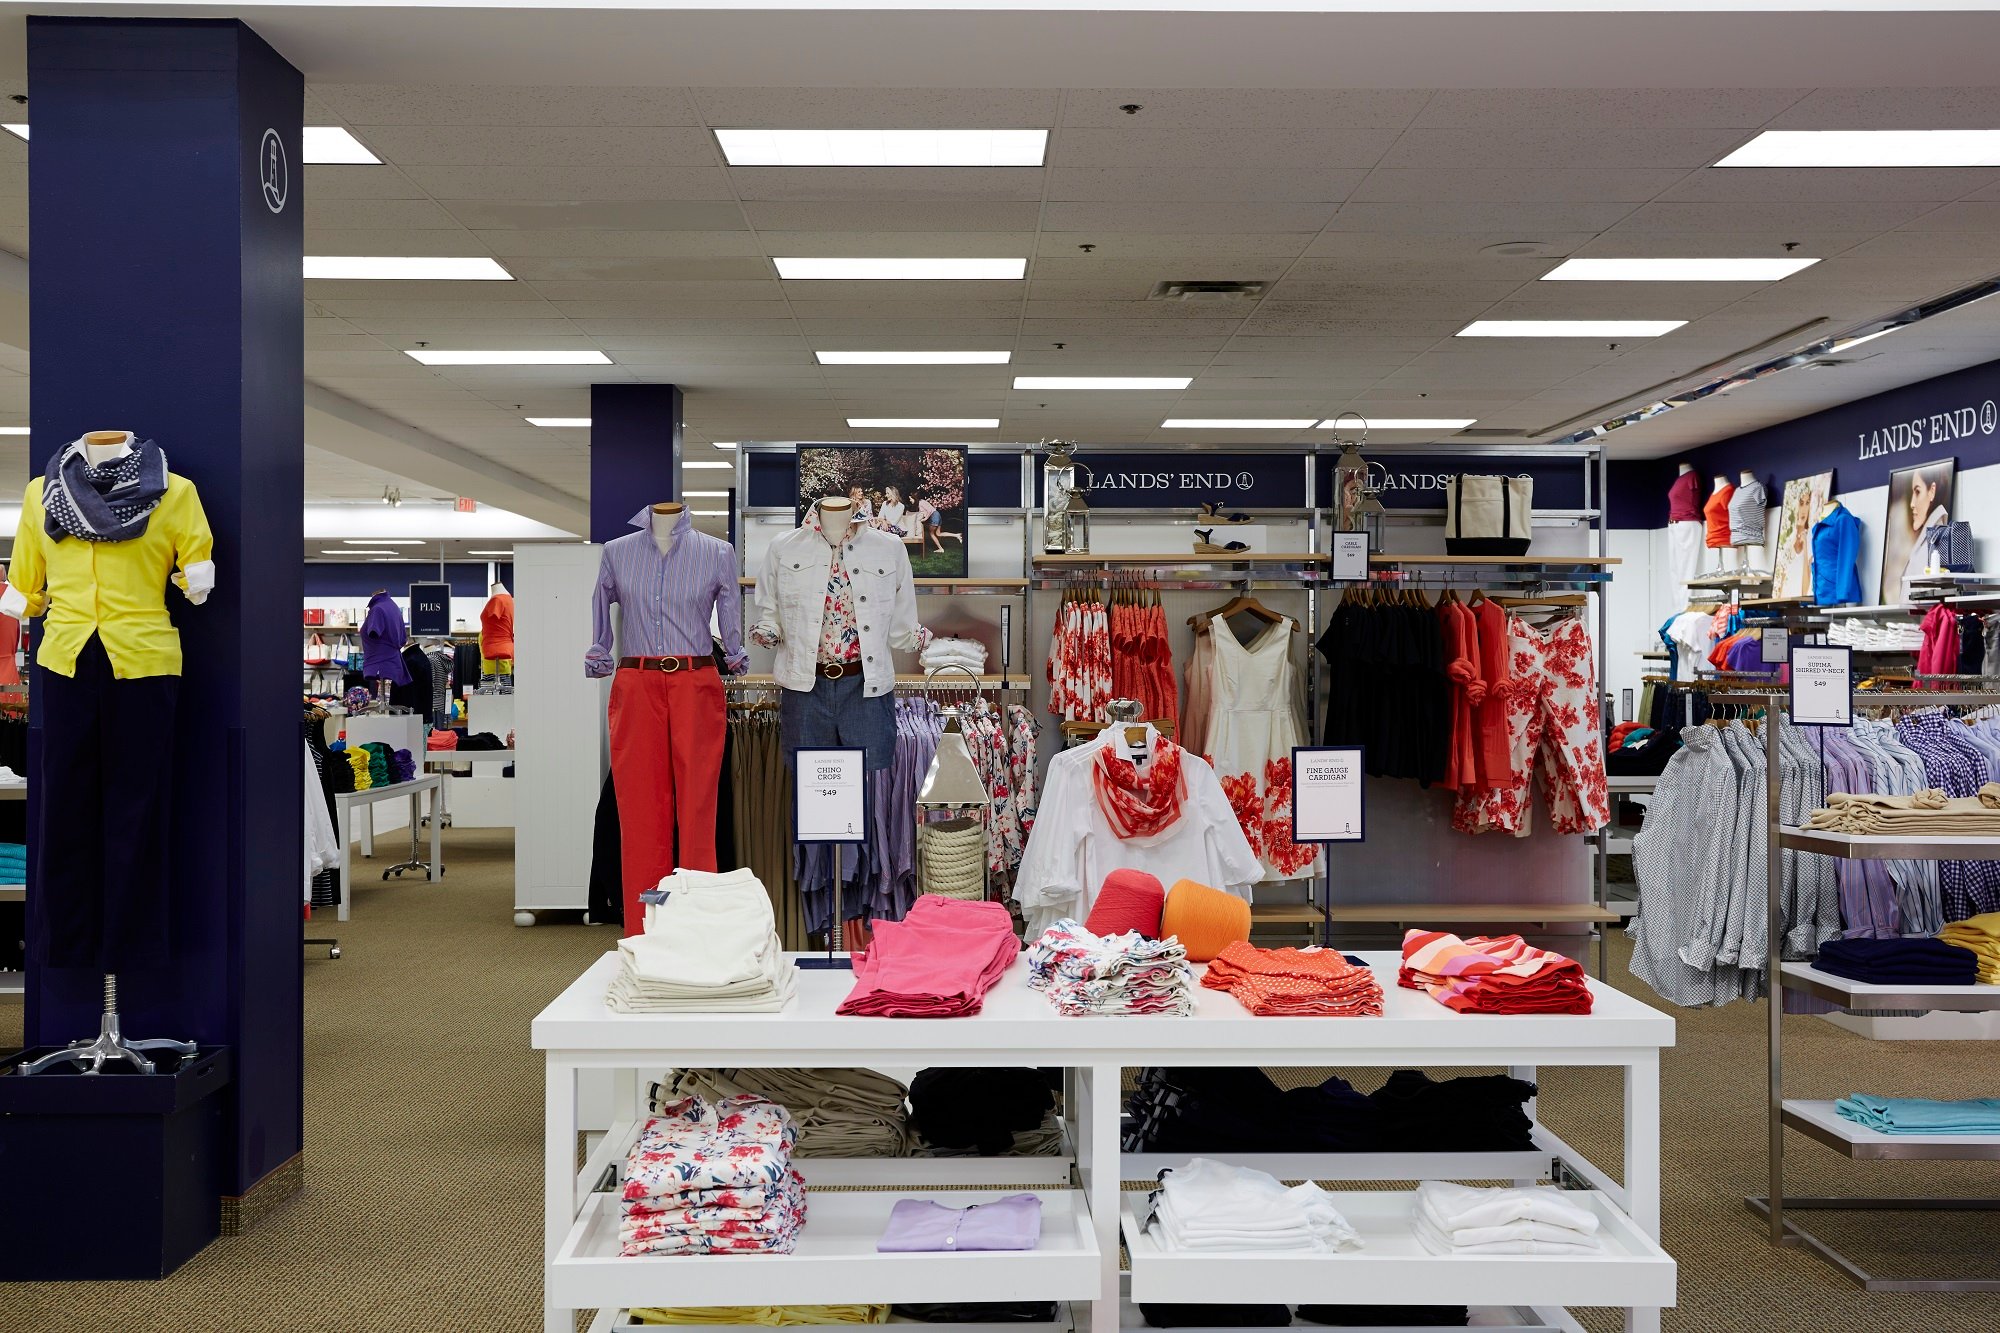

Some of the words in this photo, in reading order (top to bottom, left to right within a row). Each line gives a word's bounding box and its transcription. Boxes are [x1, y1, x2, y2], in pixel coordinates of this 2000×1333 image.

[1859, 418, 1927, 460] LANDS'
[1929, 407, 1977, 444] END
[1086, 473, 1174, 489] LANDS'
[1179, 473, 1232, 489] END
[420, 602, 441, 612] PLUS
[822, 789, 837, 797] $49
